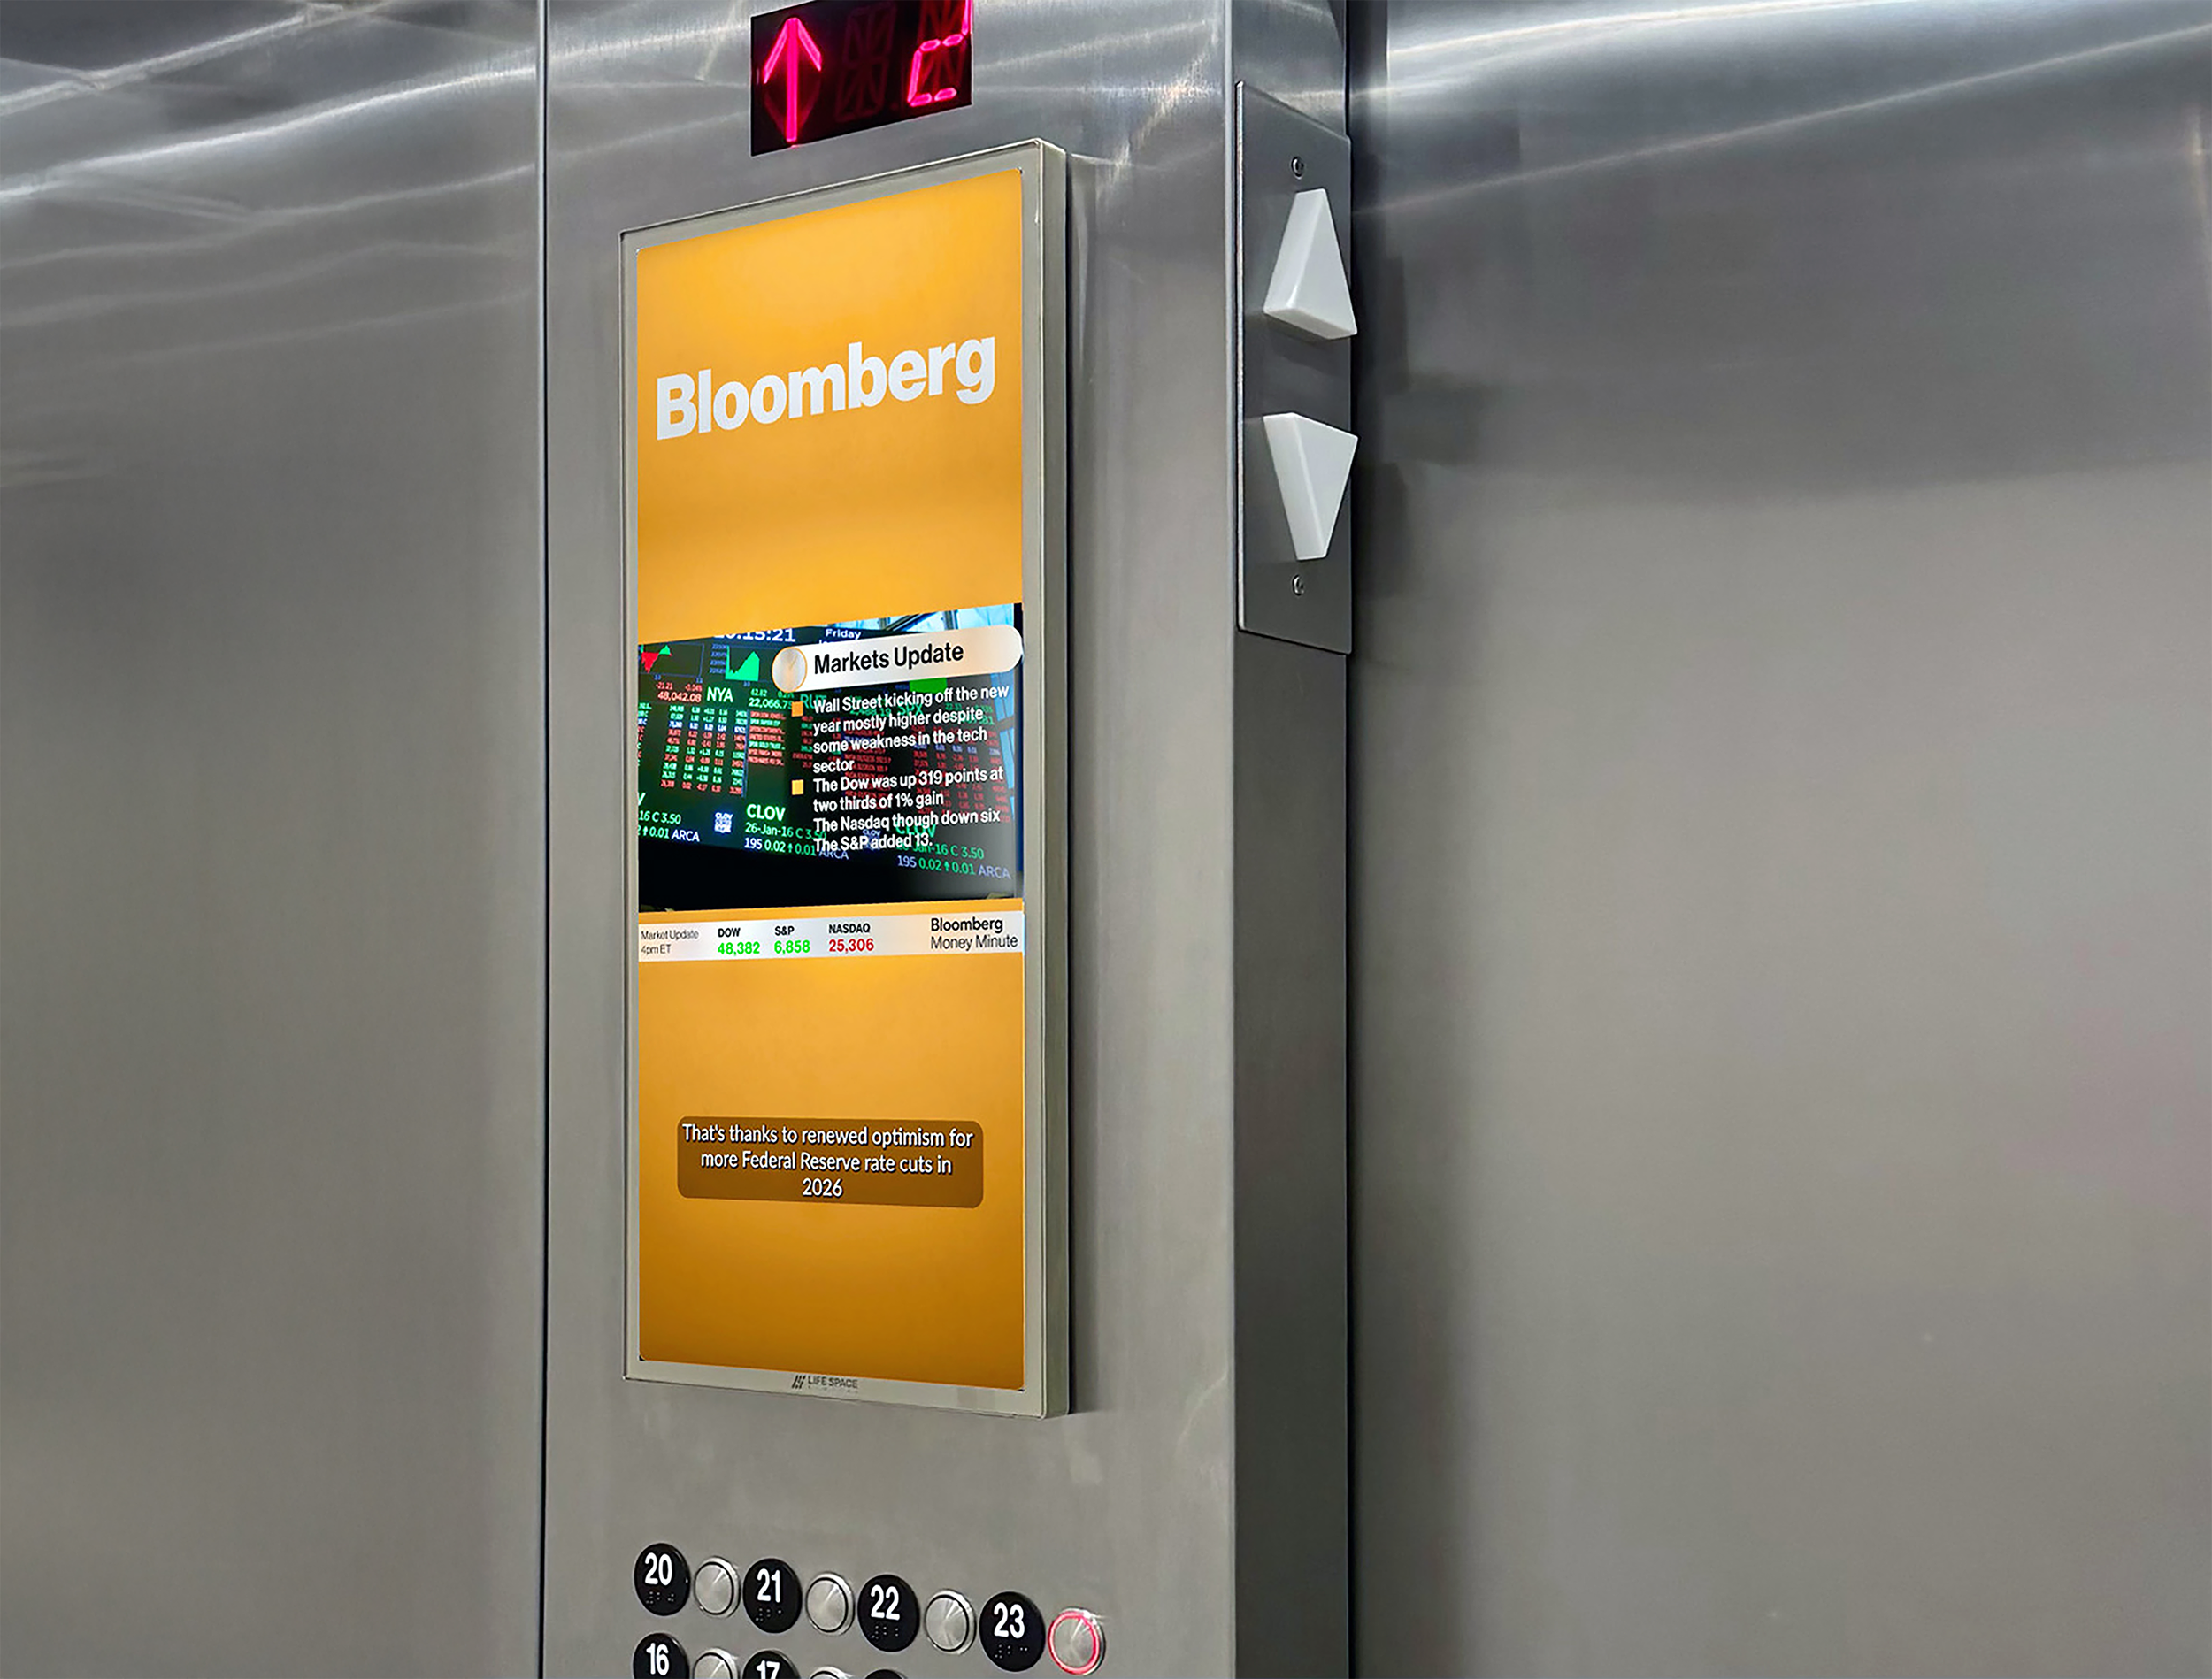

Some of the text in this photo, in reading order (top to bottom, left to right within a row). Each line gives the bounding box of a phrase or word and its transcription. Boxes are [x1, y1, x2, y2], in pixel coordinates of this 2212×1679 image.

[657, 336, 995, 440] Bloomberg
[826, 628, 861, 640] Friday
[814, 643, 964, 674] Markets Update
[657, 691, 702, 703] 48,042.08
[707, 686, 733, 703] NYA
[813, 686, 1009, 714] Wall Street kicking off the new
[813, 720, 841, 736] year
[843, 714, 887, 732] mostly
[888, 711, 930, 730] higher
[933, 708, 984, 725] despite
[812, 726, 988, 754] some weakness in the tech
[812, 758, 855, 773] sector
[813, 766, 1004, 793] The Dow was up 319 points at
[813, 791, 944, 813] two thirds of 1% gain
[652, 812, 660, 823] C
[661, 812, 682, 825] 3.50
[747, 803, 786, 821] CLOV
[813, 808, 1001, 832] The Nasdaq though down six
[649, 826, 670, 839] 0.01
[671, 829, 700, 843] ARCA
[745, 822, 794, 837] 26-Jan-16
[795, 828, 804, 840] C
[744, 837, 763, 850] 195
[764, 839, 786, 853] 0.02
[795, 843, 817, 856] 0.01
[813, 838, 838, 852] The
[841, 836, 871, 851] S&P
[870, 834, 912, 849] added
[914, 832, 933, 847] 13.
[950, 845, 959, 857] C
[961, 846, 985, 860] 3.50
[897, 855, 1011, 880] 195 0.02 0.01 ARCA
[718, 928, 741, 938] DOW
[775, 925, 795, 936] S&P
[828, 923, 871, 934] NASDAQ
[931, 916, 1003, 934] Bloomberg
[641, 929, 699, 942] Market Update
[931, 934, 1018, 951] Money Minute
[641, 944, 672, 955] 4pm ET
[718, 941, 760, 956] 48,382
[774, 939, 810, 955] 6,858
[829, 938, 874, 954] 25,306
[682, 1123, 973, 1149] That's thanks to renewed optimism for
[701, 1151, 952, 1174] more Federal Reserve rate cuts in
[803, 1177, 843, 1197] 2026
[808, 1376, 858, 1389] LIFE SPACE
[644, 1552, 672, 1585] 20
[757, 1568, 780, 1602] 21
[870, 1584, 901, 1621] 22
[993, 1602, 1025, 1637] 23
[646, 1642, 670, 1675] 16
[756, 1660, 780, 1679] 17
